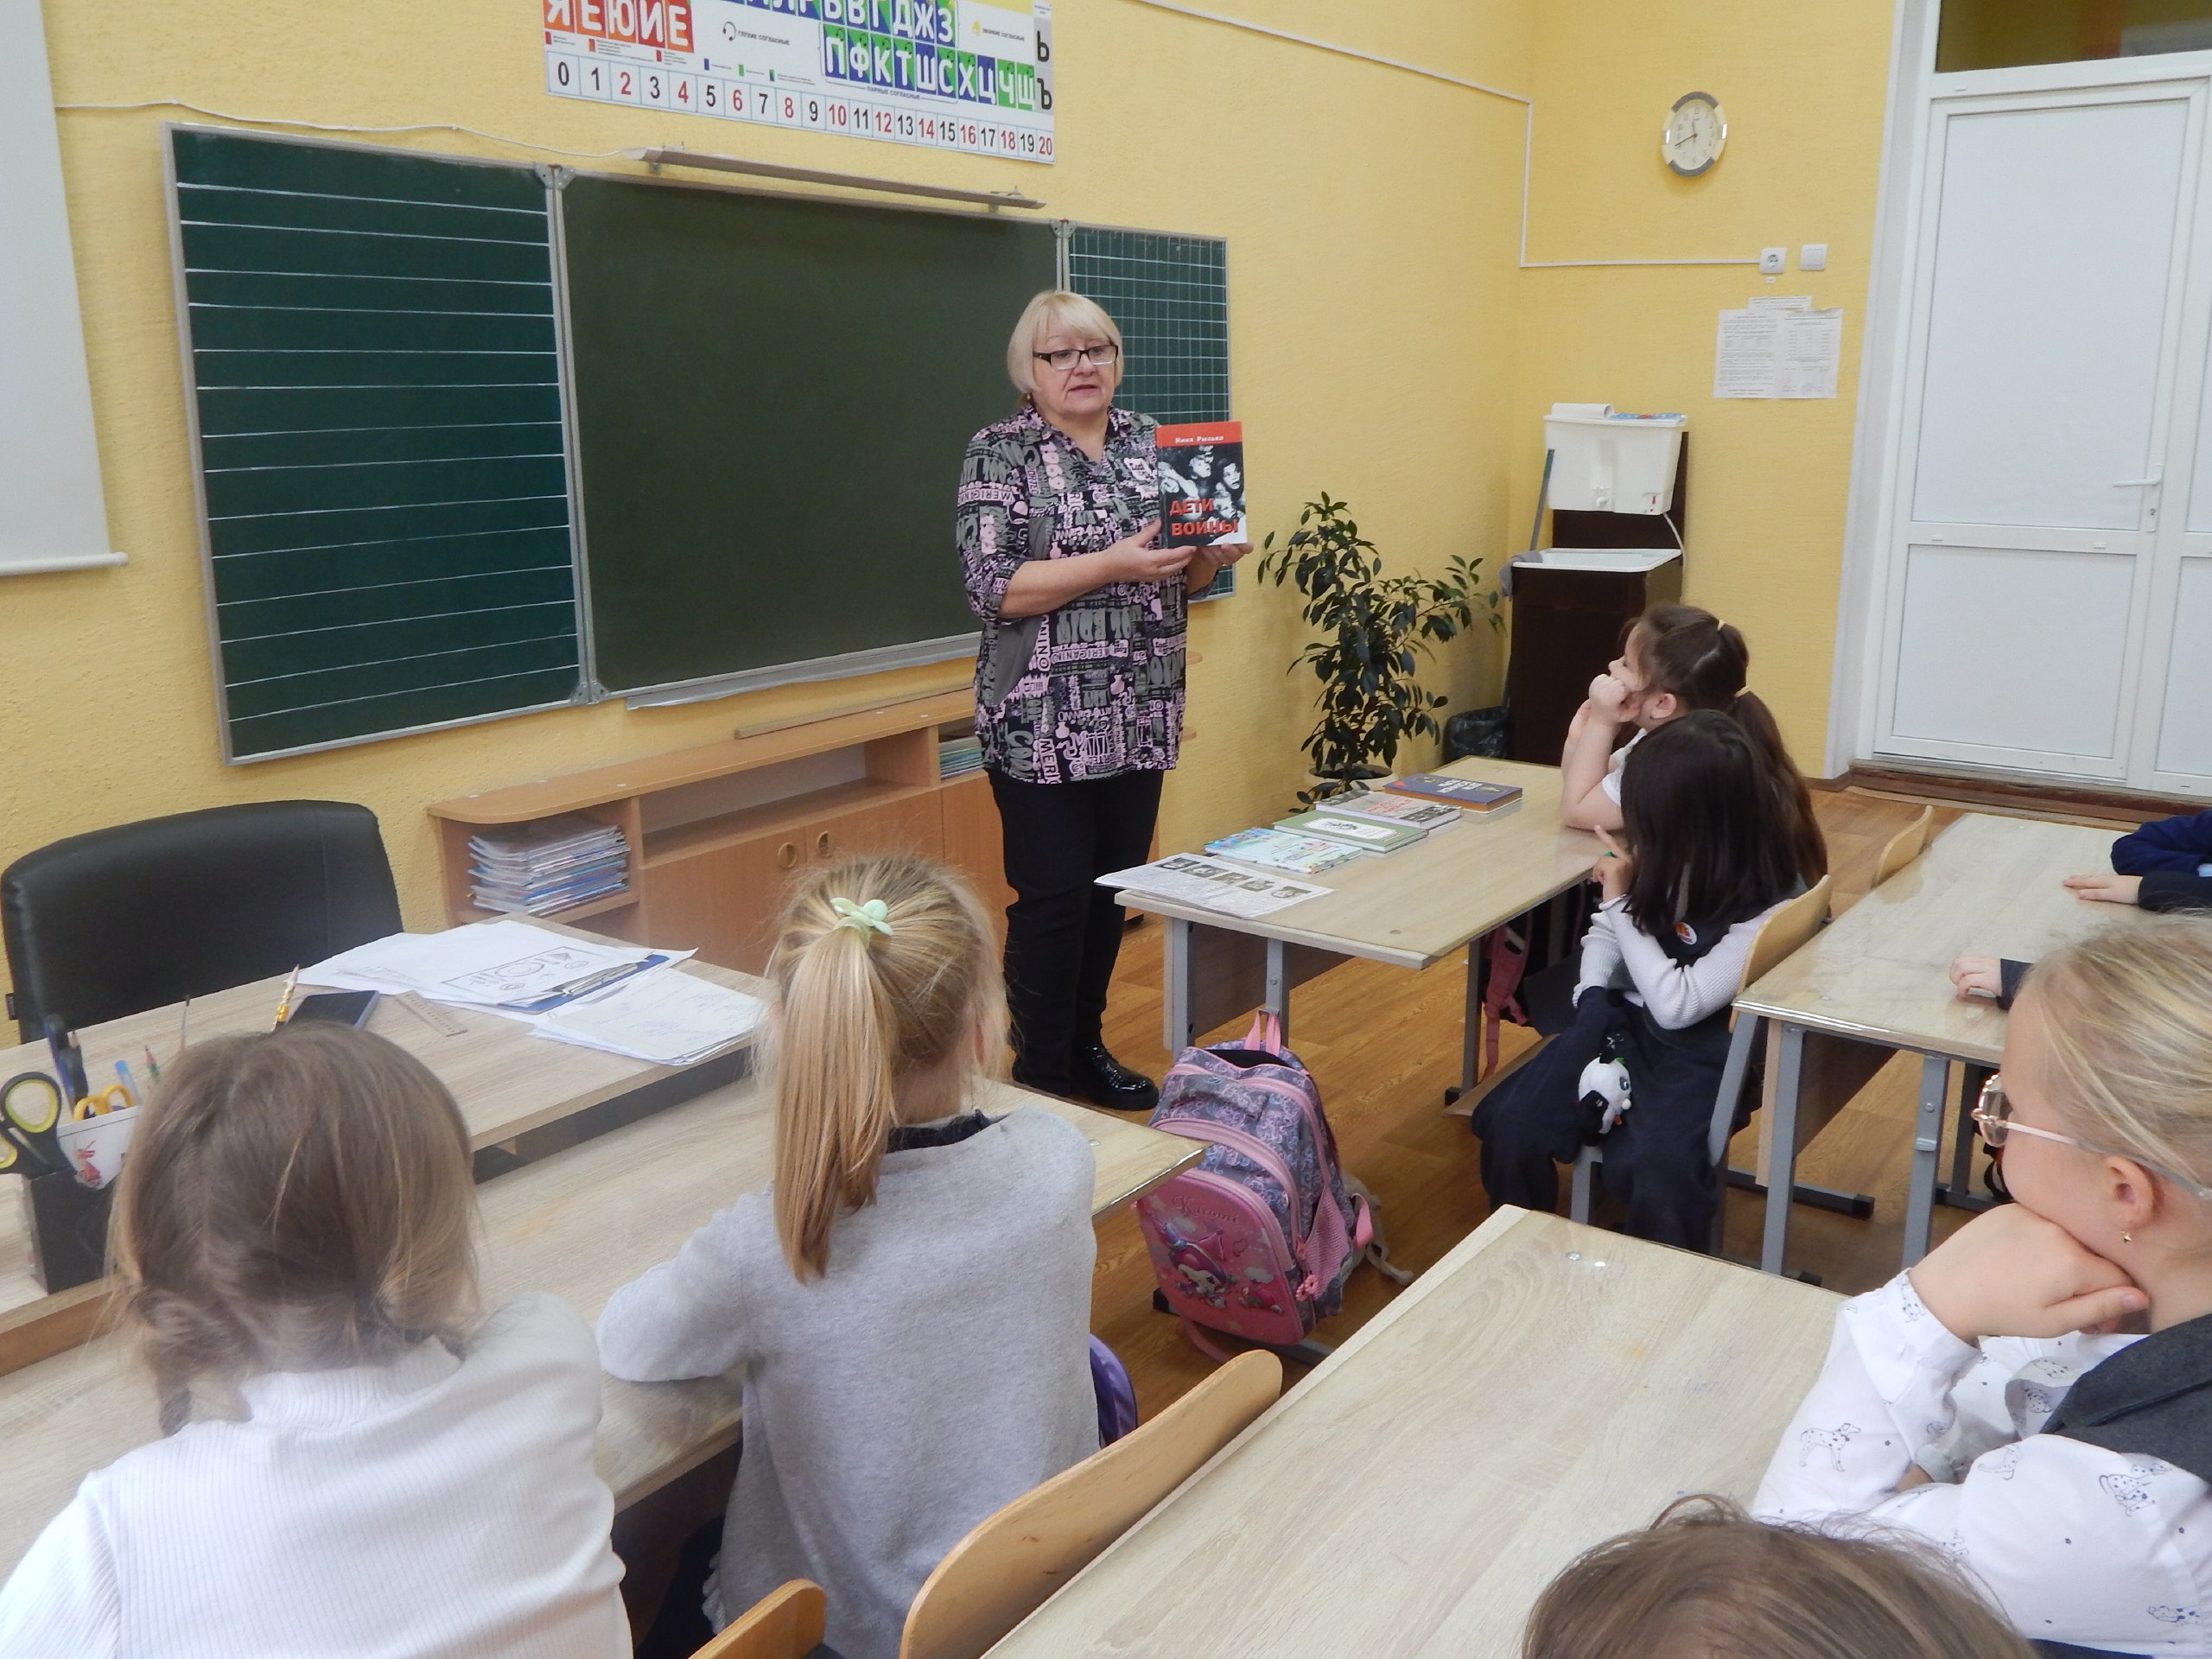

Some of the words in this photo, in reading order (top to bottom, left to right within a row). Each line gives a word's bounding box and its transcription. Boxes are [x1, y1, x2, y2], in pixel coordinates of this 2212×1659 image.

[558, 61, 569, 86] 0
[591, 67, 600, 91] 1
[620, 72, 632, 95] 2
[650, 76, 661, 99] 3
[677, 81, 689, 103] 4
[706, 85, 715, 107] 5
[733, 89, 743, 111] 6
[759, 93, 768, 114] 7
[785, 97, 794, 118] 8
[809, 100, 818, 122] 9
[829, 104, 847, 126] 10
[854, 108, 869, 130] 11
[875, 112, 892, 133] 12
[898, 115, 914, 136] 13
[918, 118, 934, 139] 14
[940, 121, 956, 143] 15
[960, 125, 976, 144] 16
[981, 128, 995, 147] 17
[1001, 131, 1016, 150] 18
[1020, 133, 1034, 153] 19
[1039, 136, 1052, 156] 20
[1170, 499, 1215, 517] ДЕТИ
[1172, 518, 1239, 537] ВОЙНЫ
